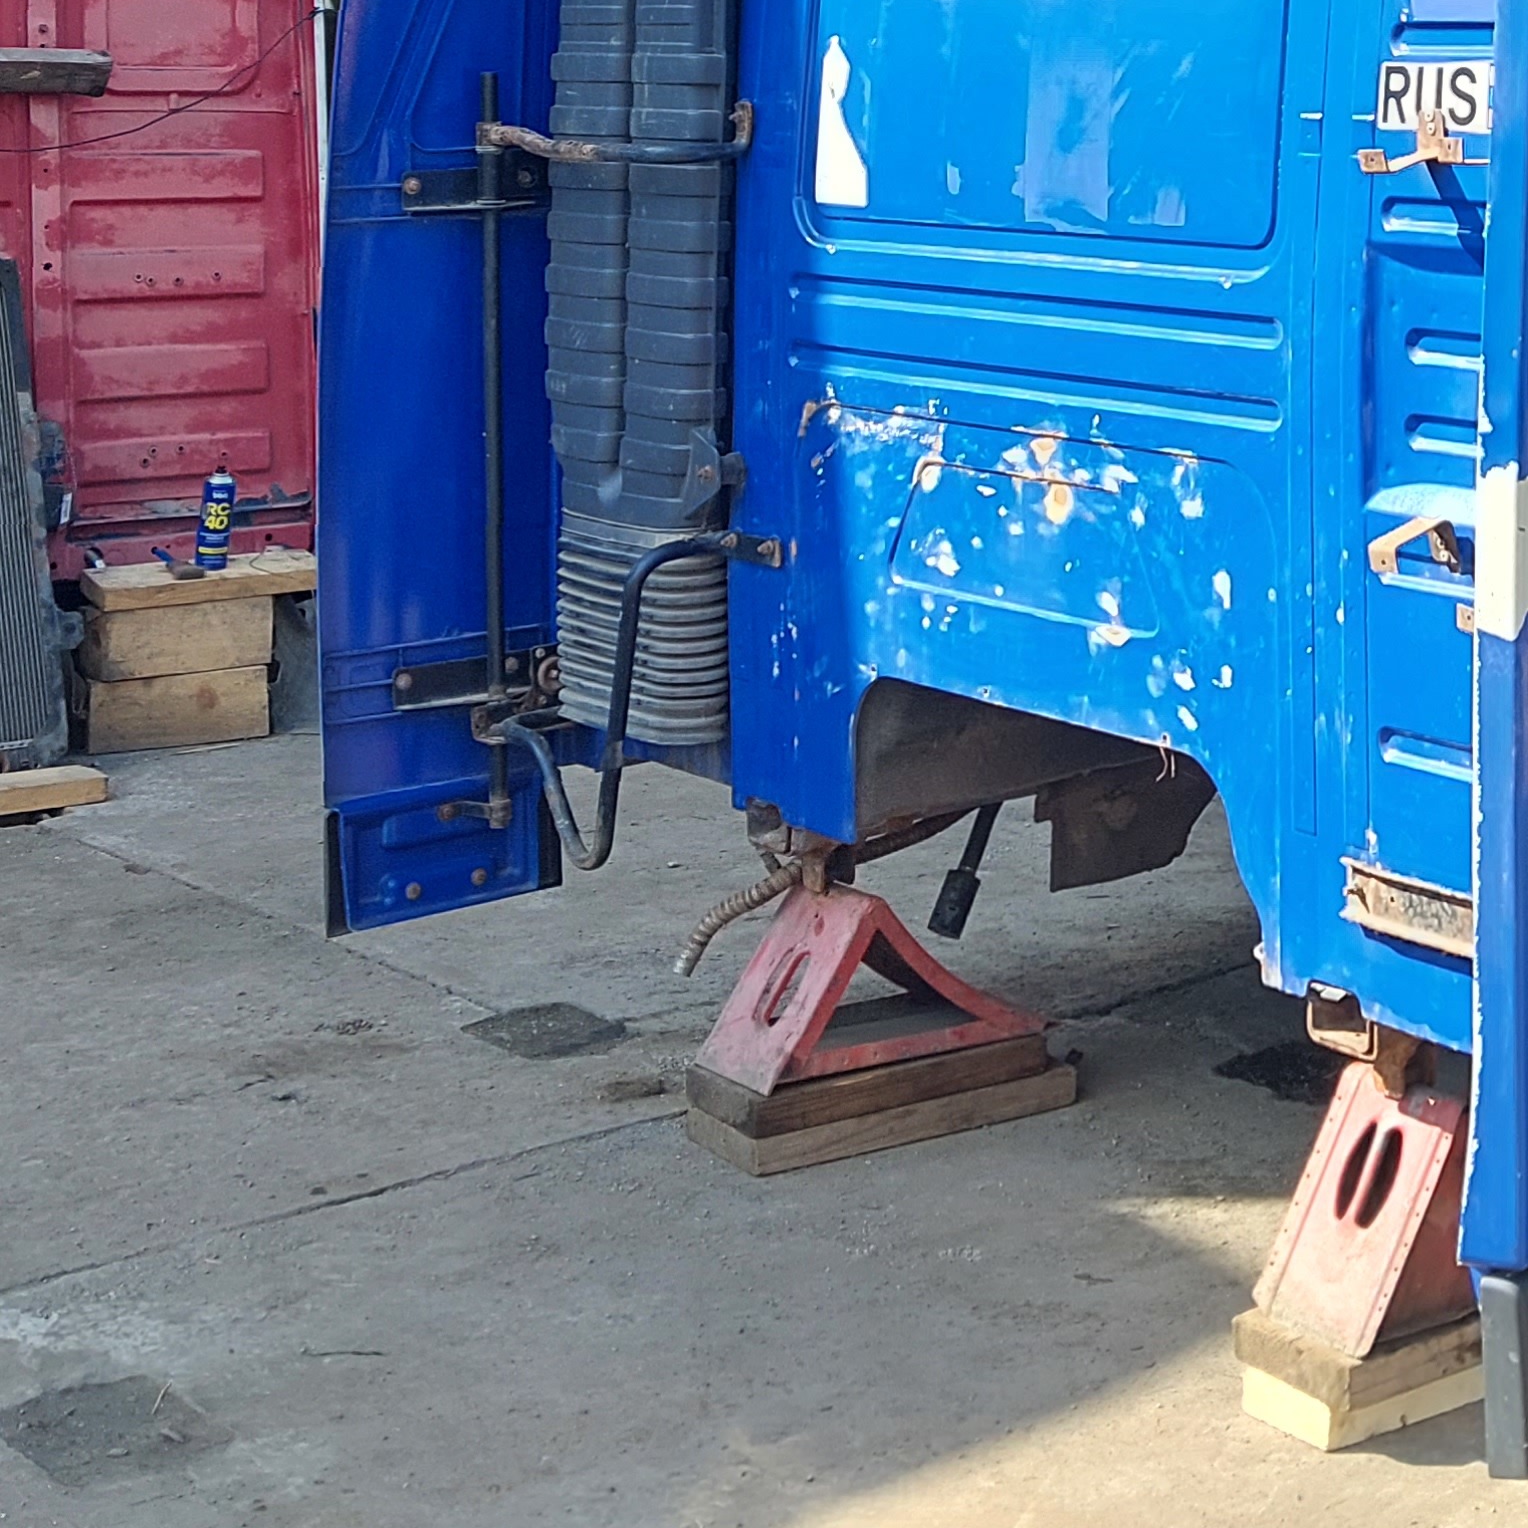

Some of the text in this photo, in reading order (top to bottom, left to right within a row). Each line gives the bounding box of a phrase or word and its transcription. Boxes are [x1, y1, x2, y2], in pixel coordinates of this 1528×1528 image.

[1382, 65, 1477, 126] RUS
[206, 502, 231, 516] RC
[204, 515, 229, 530] 40
